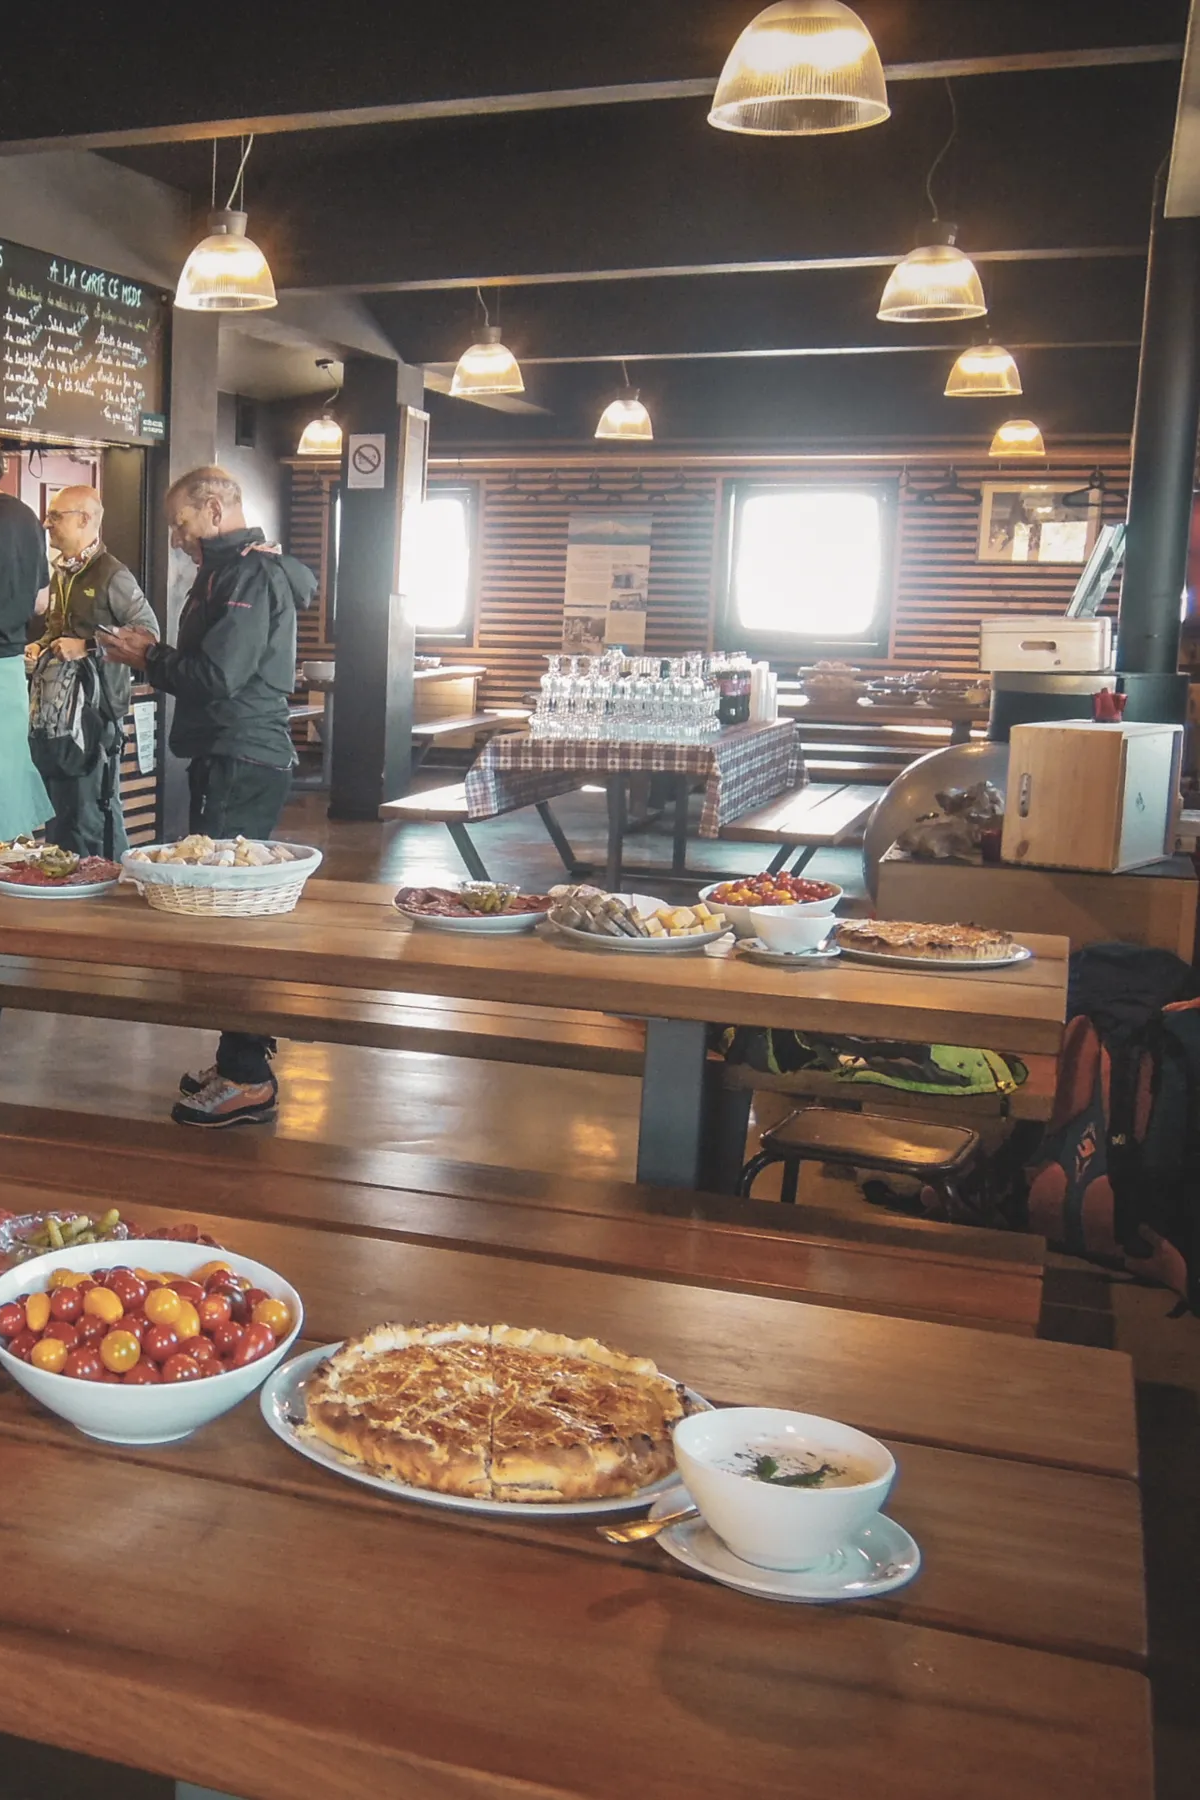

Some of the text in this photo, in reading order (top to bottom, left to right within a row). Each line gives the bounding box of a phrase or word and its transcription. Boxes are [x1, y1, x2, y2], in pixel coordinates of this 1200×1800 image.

[63, 264, 77, 288] LA
[80, 270, 106, 298] CARTE
[108, 278, 119, 300] CE
[121, 284, 142, 308] MIDI
